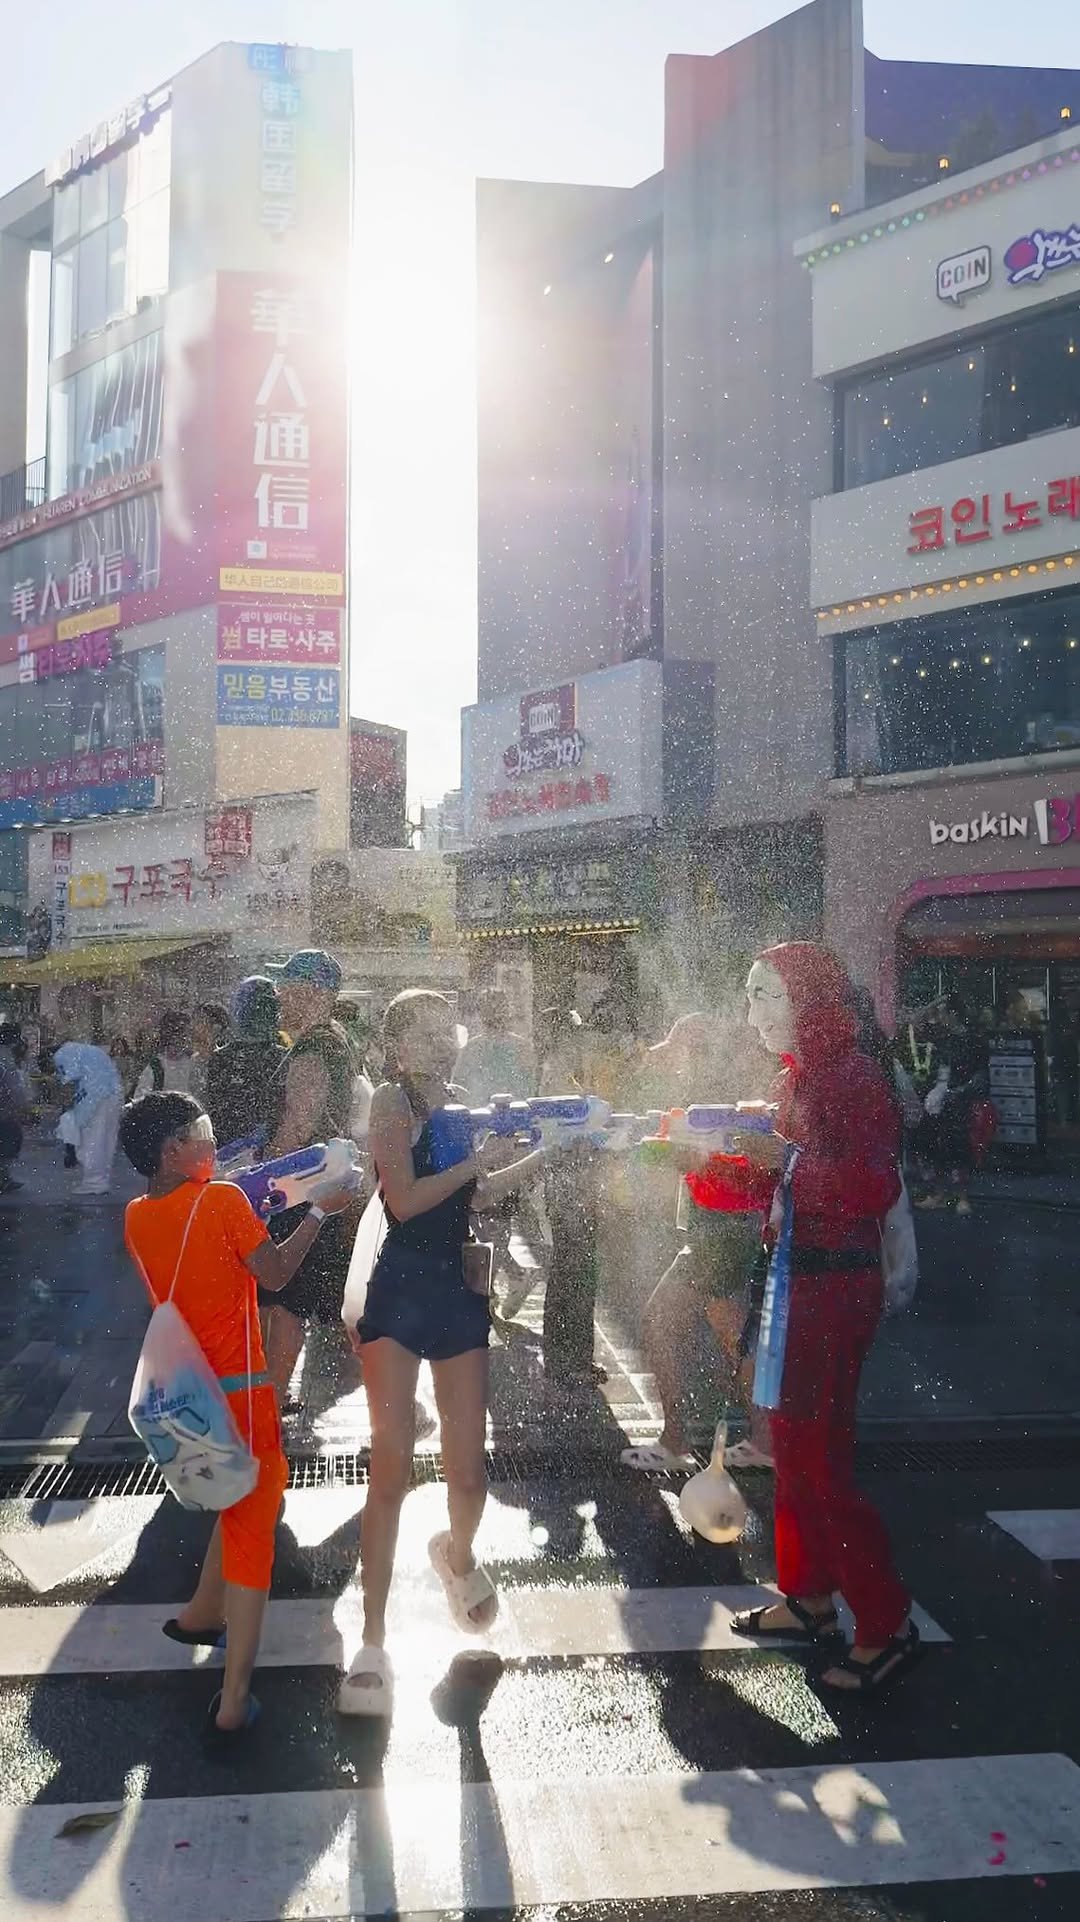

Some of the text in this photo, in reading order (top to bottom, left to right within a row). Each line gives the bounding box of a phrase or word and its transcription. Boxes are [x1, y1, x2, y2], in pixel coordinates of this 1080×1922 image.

[941, 255, 986, 289] COIN
[252, 288, 310, 530] 華人通信
[11, 550, 122, 622] 華人通信
